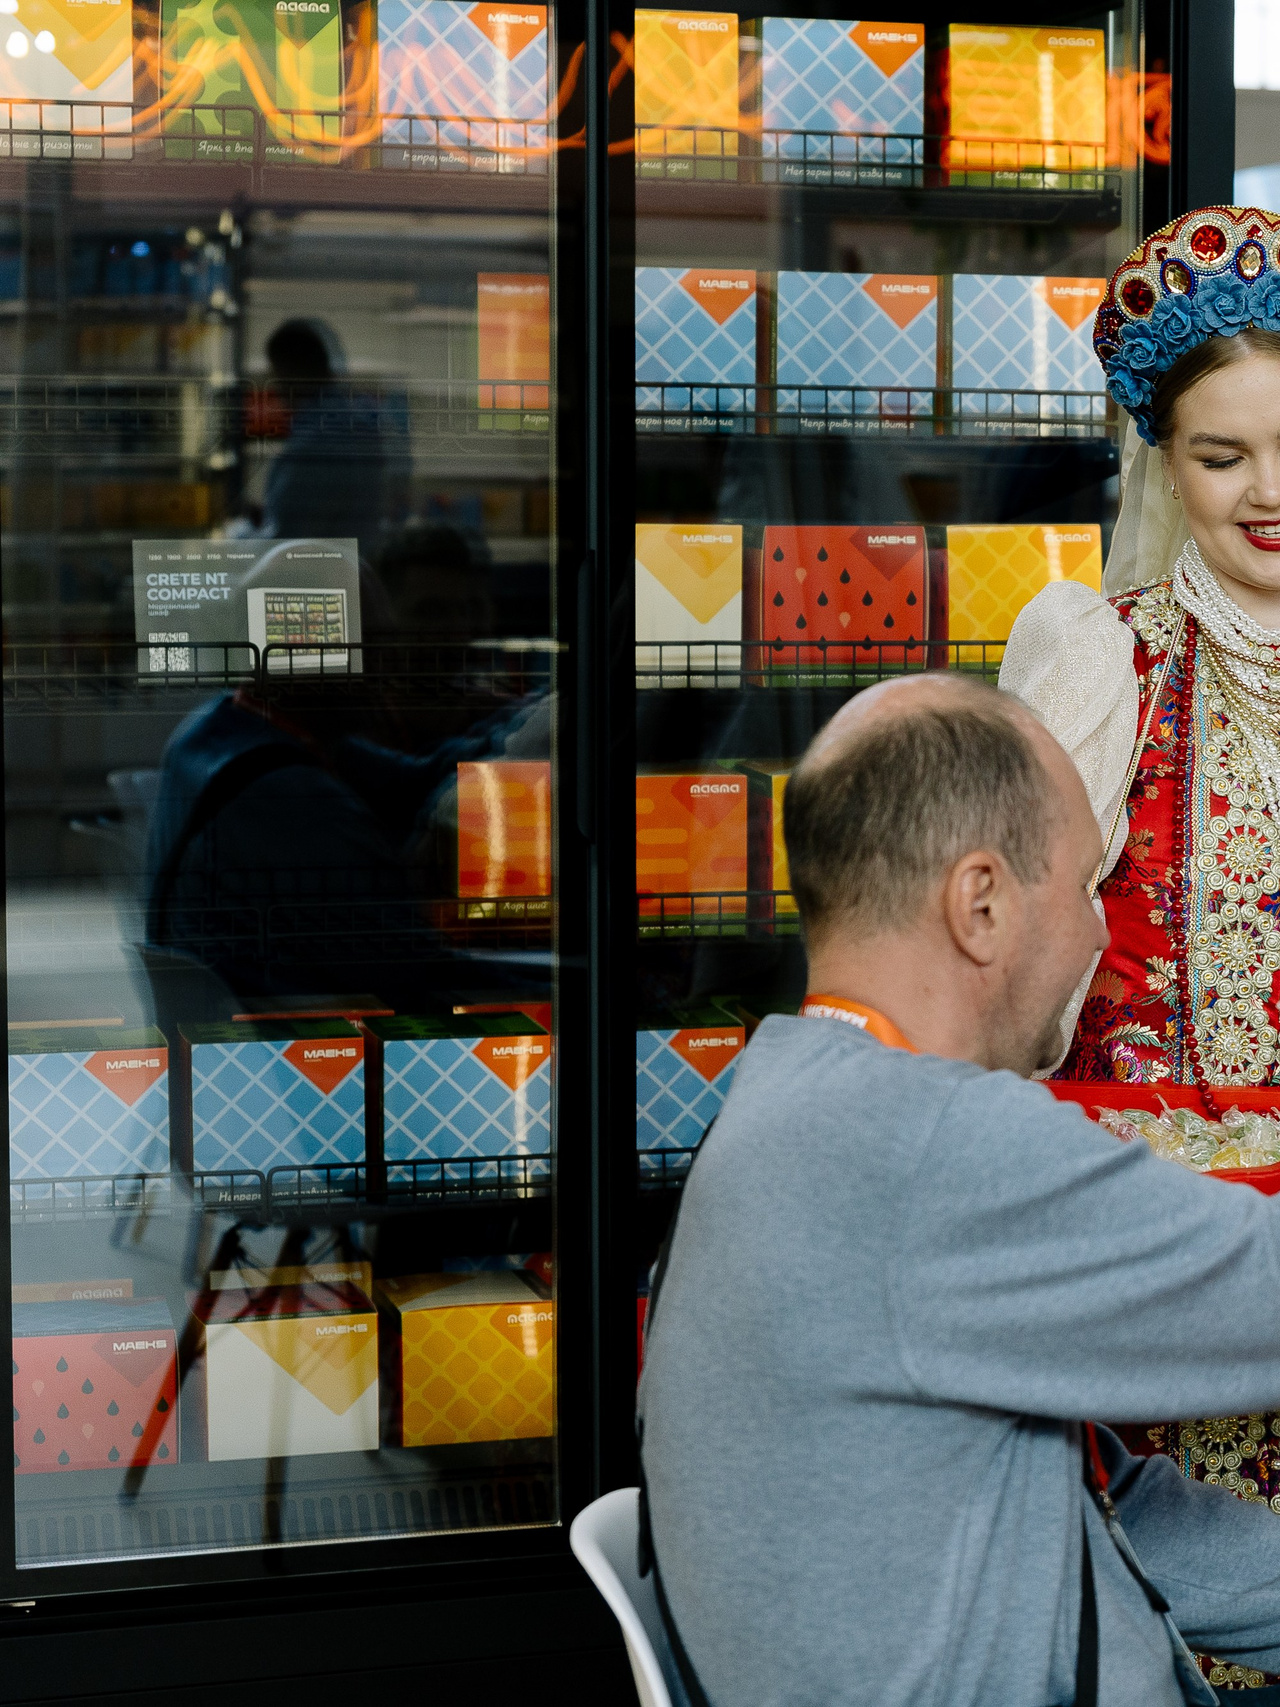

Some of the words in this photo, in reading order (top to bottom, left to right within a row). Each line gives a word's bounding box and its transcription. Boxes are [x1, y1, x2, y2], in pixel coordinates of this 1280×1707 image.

[33, 141, 93, 152] гризоты
[233, 142, 305, 155] впетленя
[146, 573, 200, 586] CRETE
[205, 572, 229, 585] NT
[146, 587, 231, 601] COMPACT
